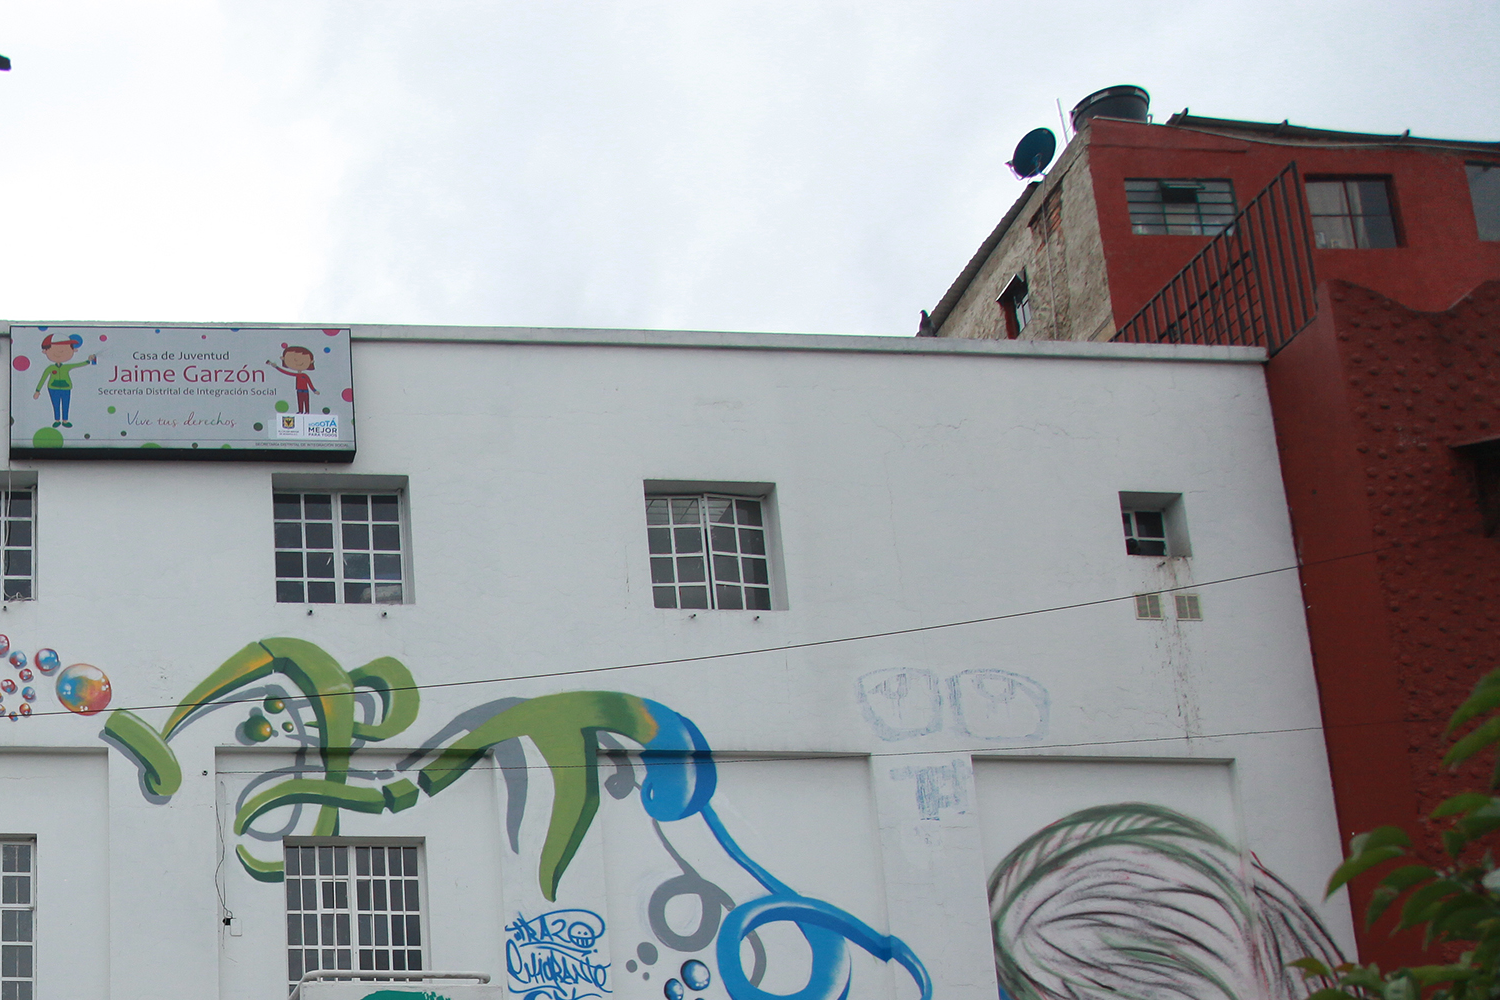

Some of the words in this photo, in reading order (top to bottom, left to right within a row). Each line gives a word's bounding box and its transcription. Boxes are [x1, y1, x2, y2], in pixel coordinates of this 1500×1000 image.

[132, 351, 158, 361] Casa
[161, 351, 175, 361] de
[178, 351, 230, 361] Juventud
[108, 365, 176, 383] Jaime
[183, 364, 265, 383] Garzón
[97, 387, 144, 396] Secretaría
[145, 387, 181, 396] Distrital
[183, 387, 195, 396] de
[196, 387, 249, 398] Integración
[250, 387, 277, 397] Social
[126, 410, 152, 426] Vive
[157, 417, 177, 428] tus
[183, 411, 237, 428] derechos
